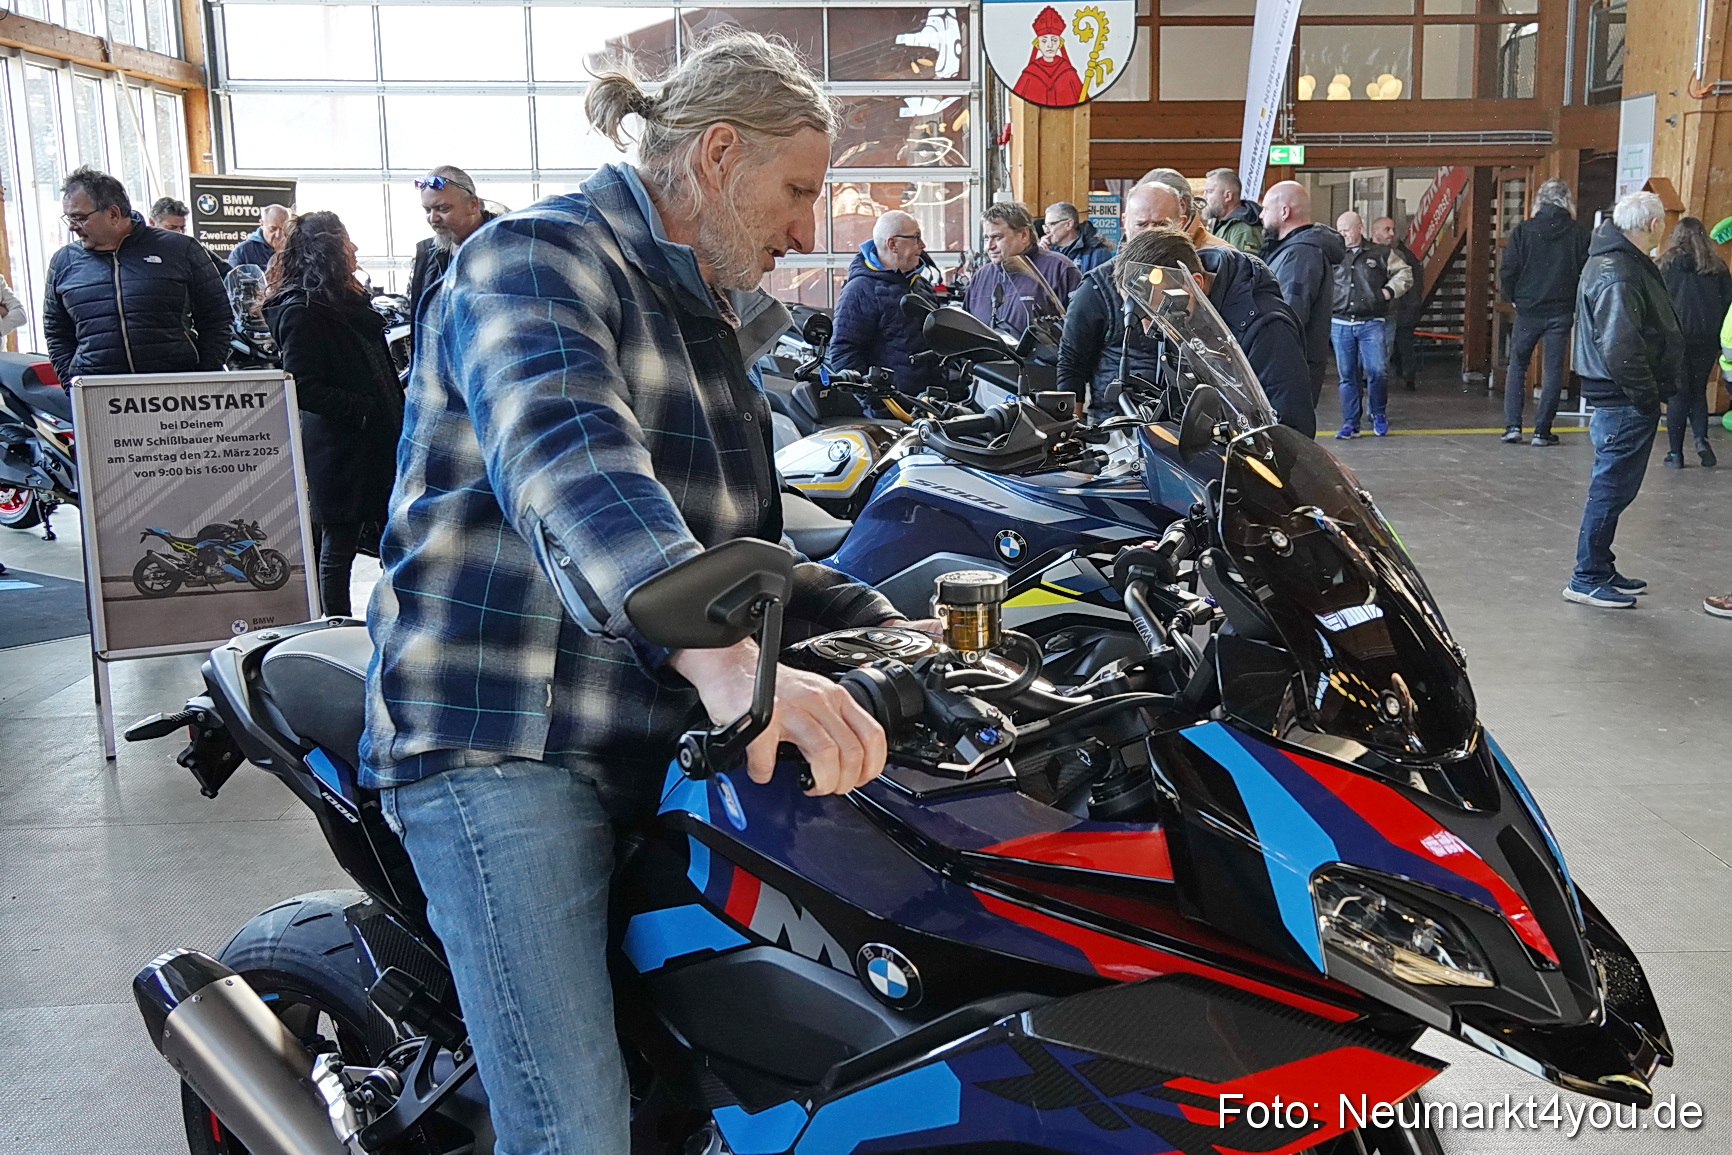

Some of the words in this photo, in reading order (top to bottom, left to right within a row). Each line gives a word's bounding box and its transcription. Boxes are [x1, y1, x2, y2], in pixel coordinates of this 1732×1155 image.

[222, 195, 254, 205] BMW
[1093, 219, 1117, 228] 2025
[199, 230, 239, 240] Zweirad
[108, 392, 268, 415] SAISONSTART
[160, 420, 178, 430] bei
[180, 419, 224, 430] Deinem
[113, 437, 144, 448] BMW
[146, 435, 214, 447] Schißlbauer
[216, 431, 271, 443] Neumarkt
[107, 456, 126, 464] am
[128, 453, 178, 463] Samstag
[180, 450, 202, 460] den
[203, 450, 221, 459] 22.
[223, 448, 251, 458] März
[252, 446, 280, 457] 2025
[134, 470, 156, 478] von
[158, 467, 183, 477] 9:00
[185, 465, 202, 476] bis
[204, 464, 235, 475] 16:00
[237, 462, 258, 473] Uhr
[252, 616, 275, 625] BMW
